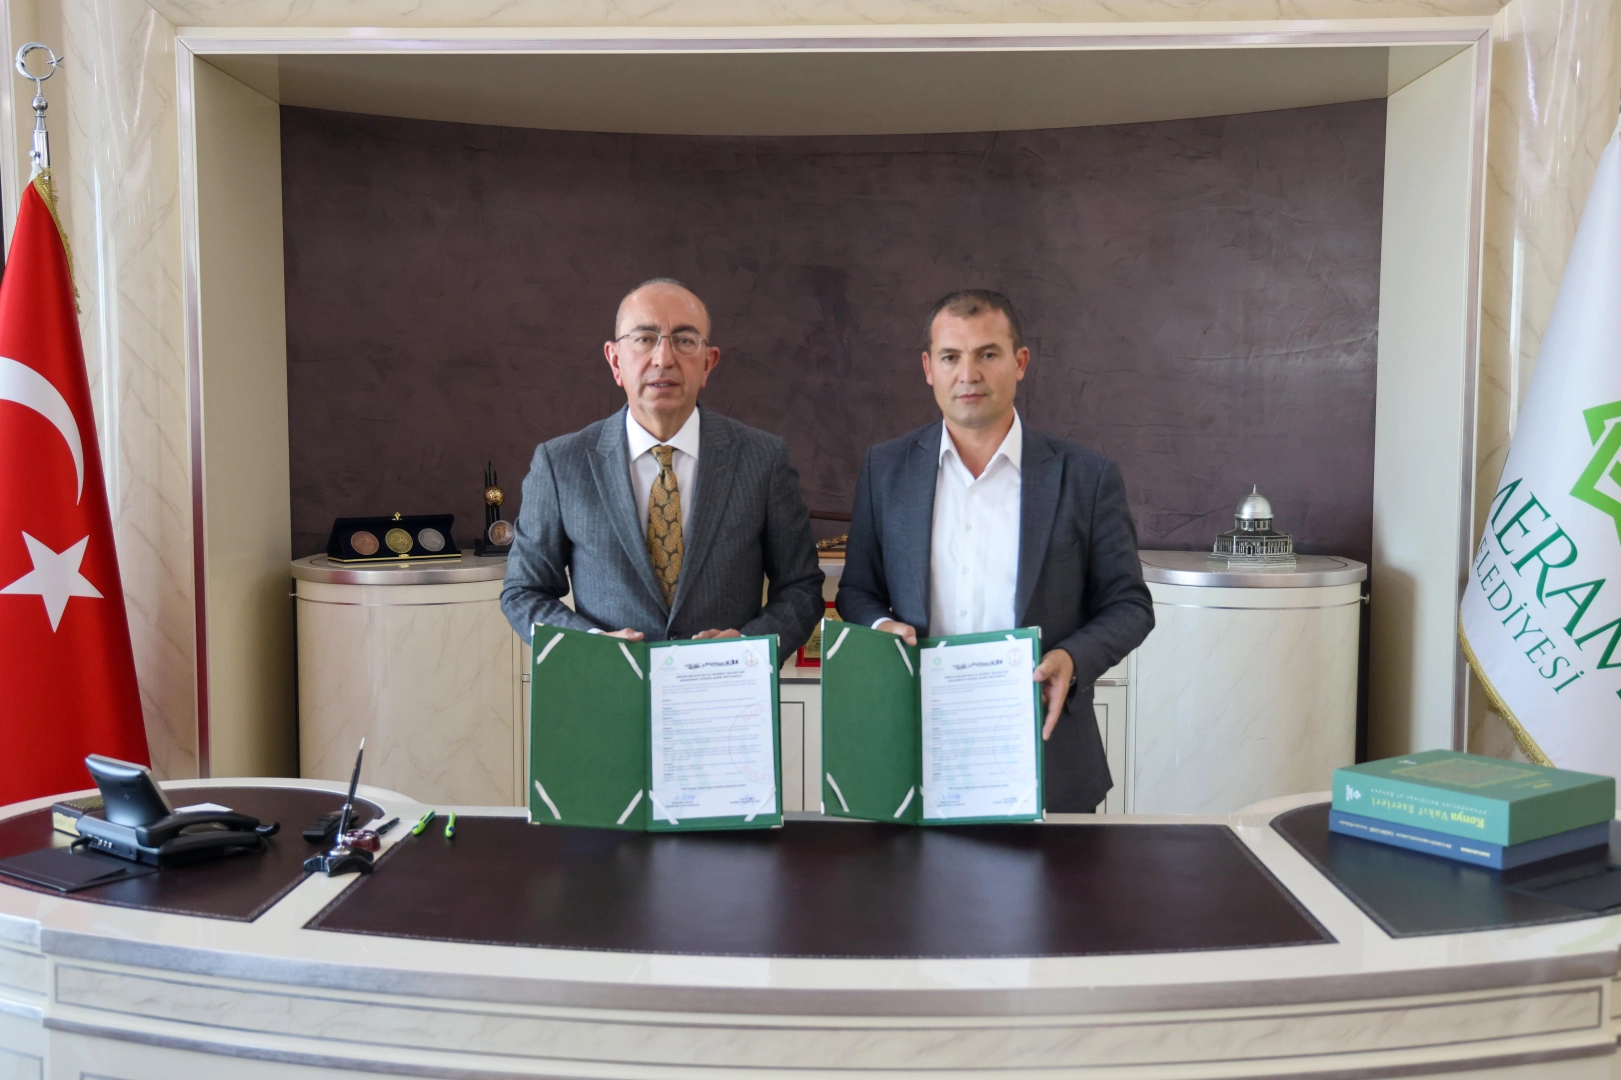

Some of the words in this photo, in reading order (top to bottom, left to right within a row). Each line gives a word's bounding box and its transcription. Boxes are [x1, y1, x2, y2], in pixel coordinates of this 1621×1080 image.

[1475, 537, 1585, 695] ELEDİYESİ
[1371, 796, 1415, 814] Eserleri
[1418, 806, 1449, 822] Vakıf
[1450, 812, 1485, 829] Konya
